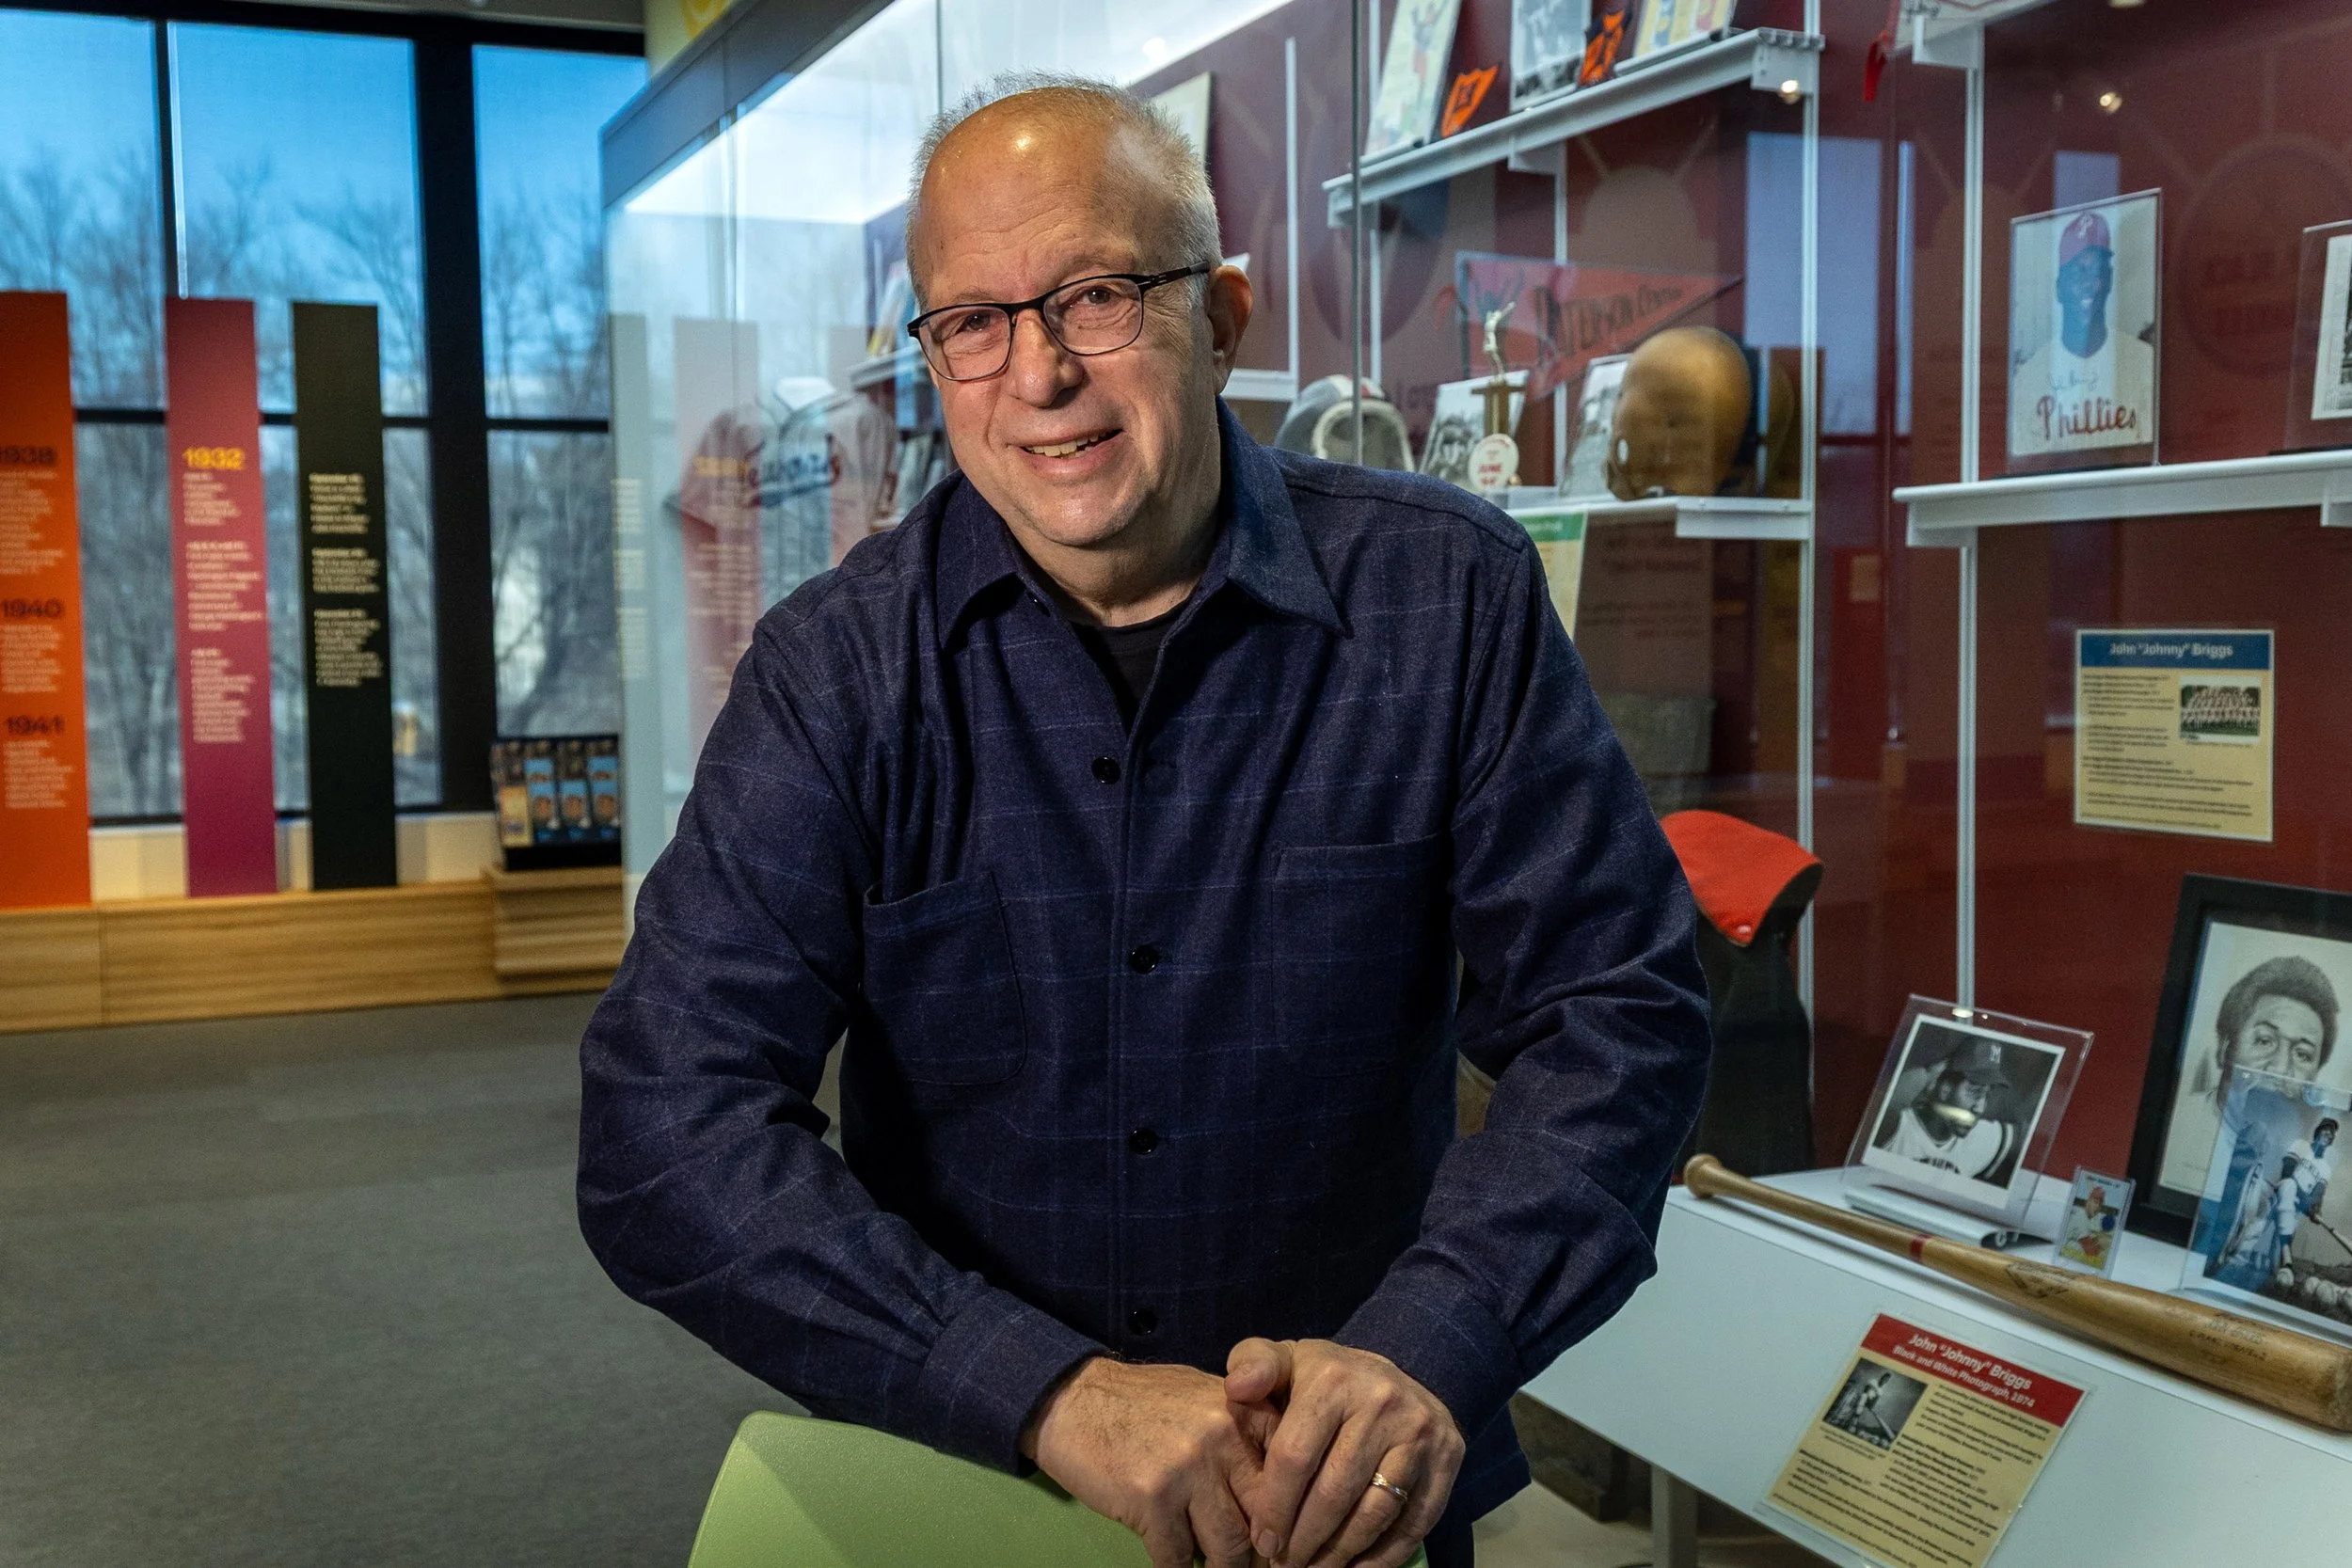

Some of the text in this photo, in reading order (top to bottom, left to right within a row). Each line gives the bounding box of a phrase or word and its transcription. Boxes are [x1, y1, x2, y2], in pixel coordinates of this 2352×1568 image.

[2037, 396, 2137, 440] Phillies
[183, 448, 244, 469] 1932
[3, 598, 63, 619] 1940
[2109, 643, 2136, 656] John
[2192, 644, 2233, 659] Briggs
[5, 716, 63, 736] 1941
[1909, 1335, 1936, 1353] John
[1991, 1365, 2031, 1389] Briggs
[1893, 1346, 2035, 1408] Black and White Photograph, 1974
